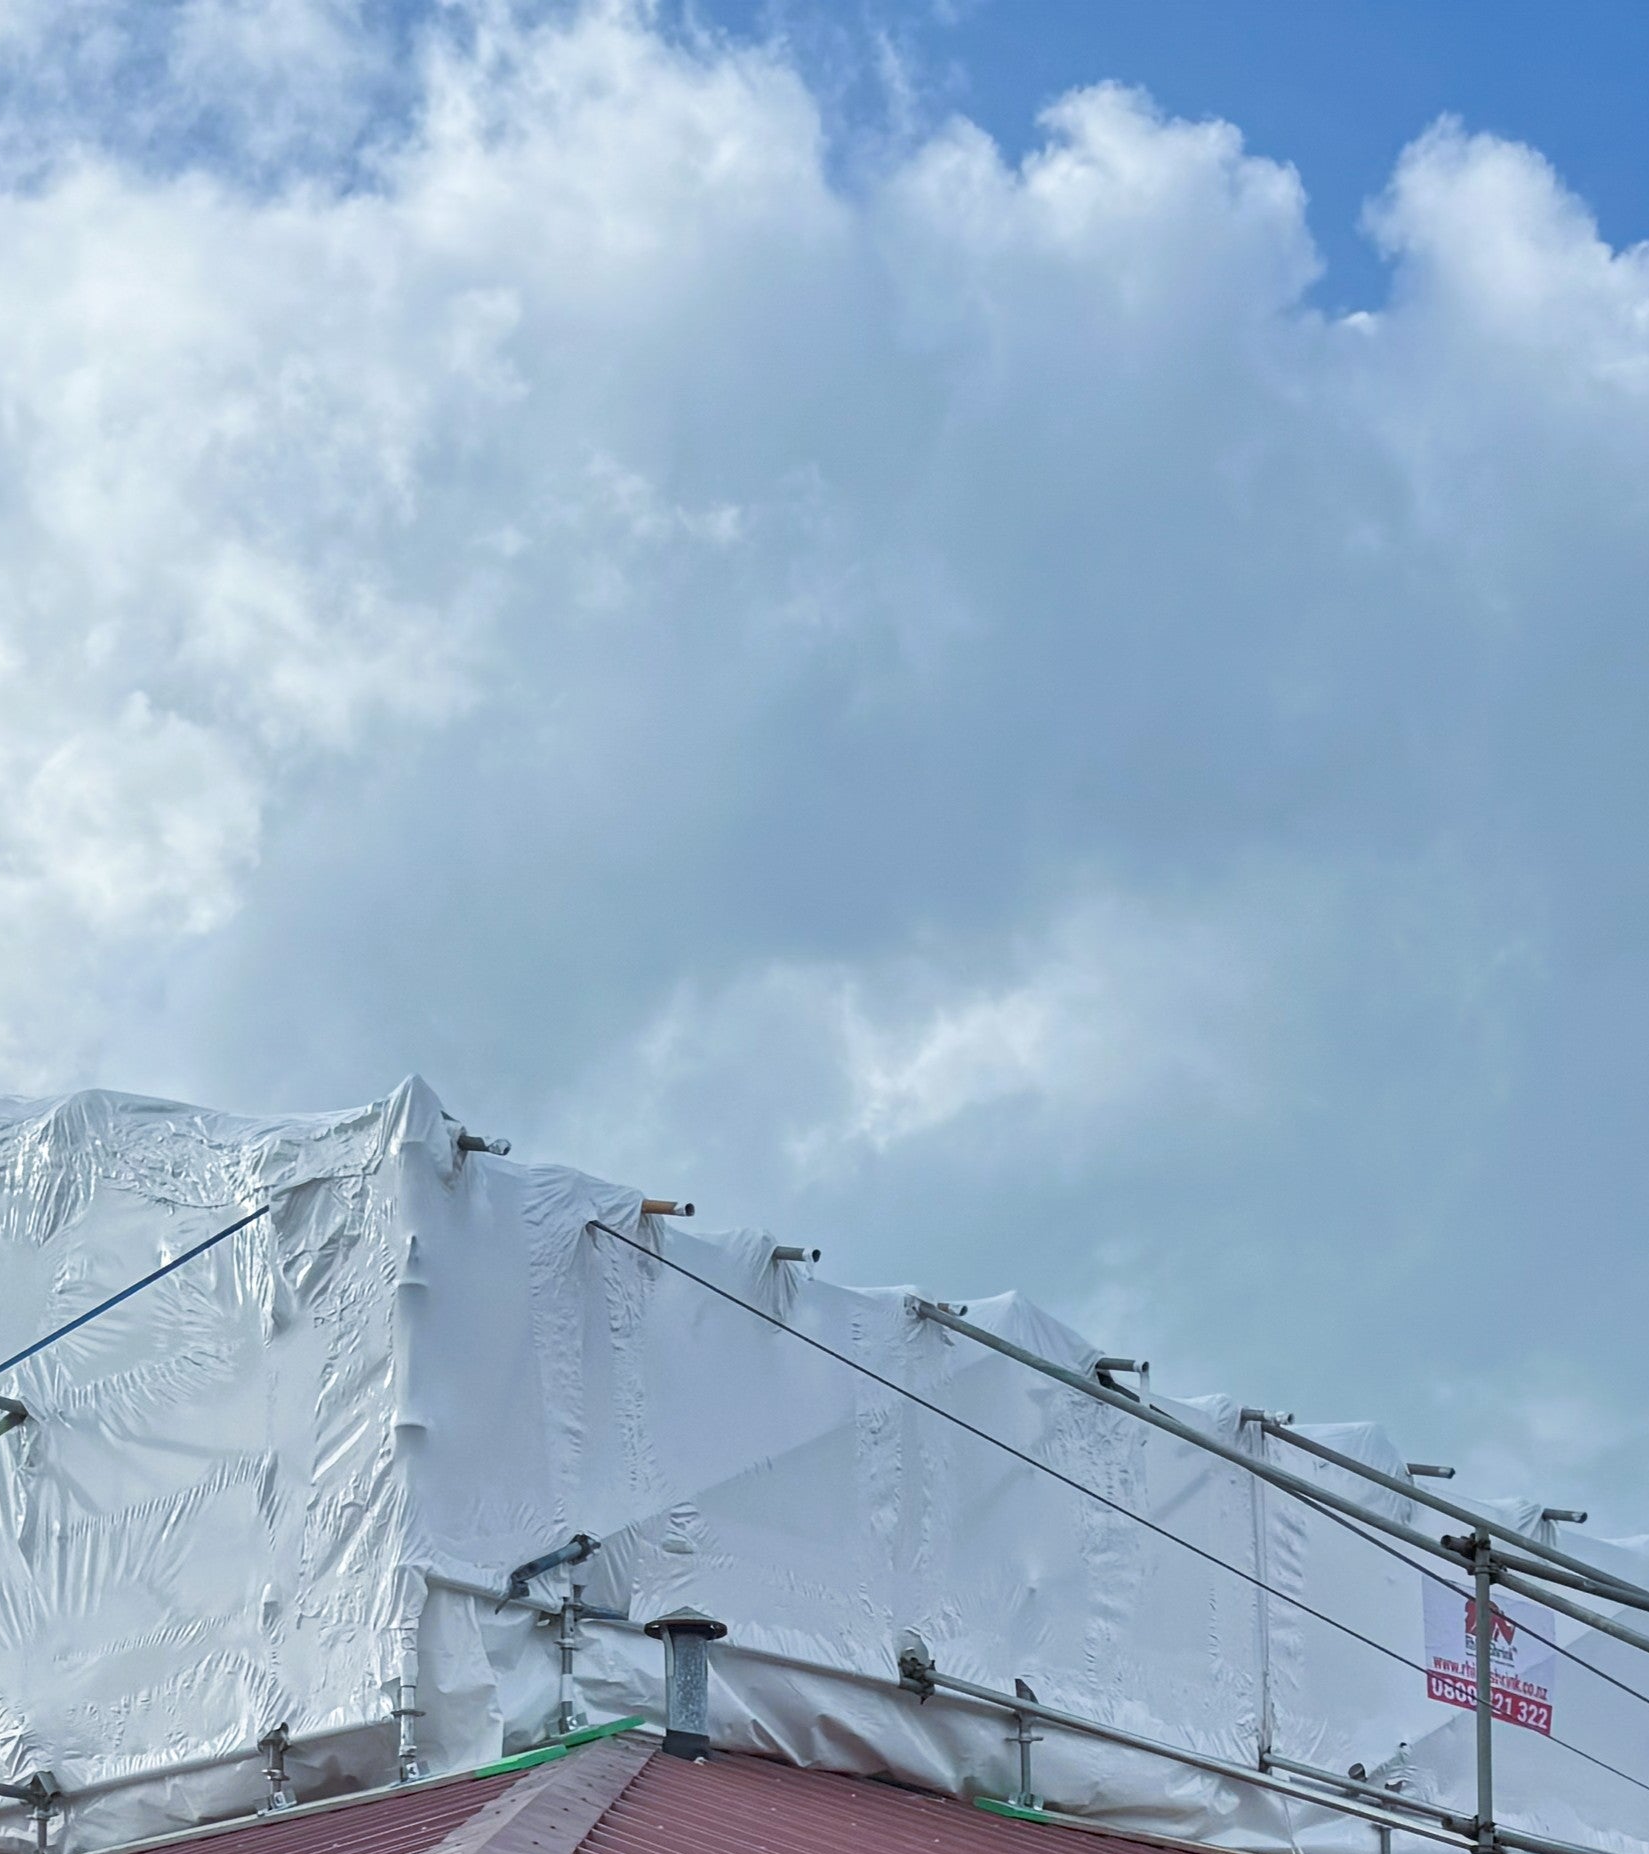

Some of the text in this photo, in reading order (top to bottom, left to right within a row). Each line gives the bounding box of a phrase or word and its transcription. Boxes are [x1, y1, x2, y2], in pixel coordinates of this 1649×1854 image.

[1433, 1656, 1547, 1701] www.rhishrink.co.nz
[1432, 1677, 1478, 1706] 0800
[1517, 1701, 1548, 1729] 322
